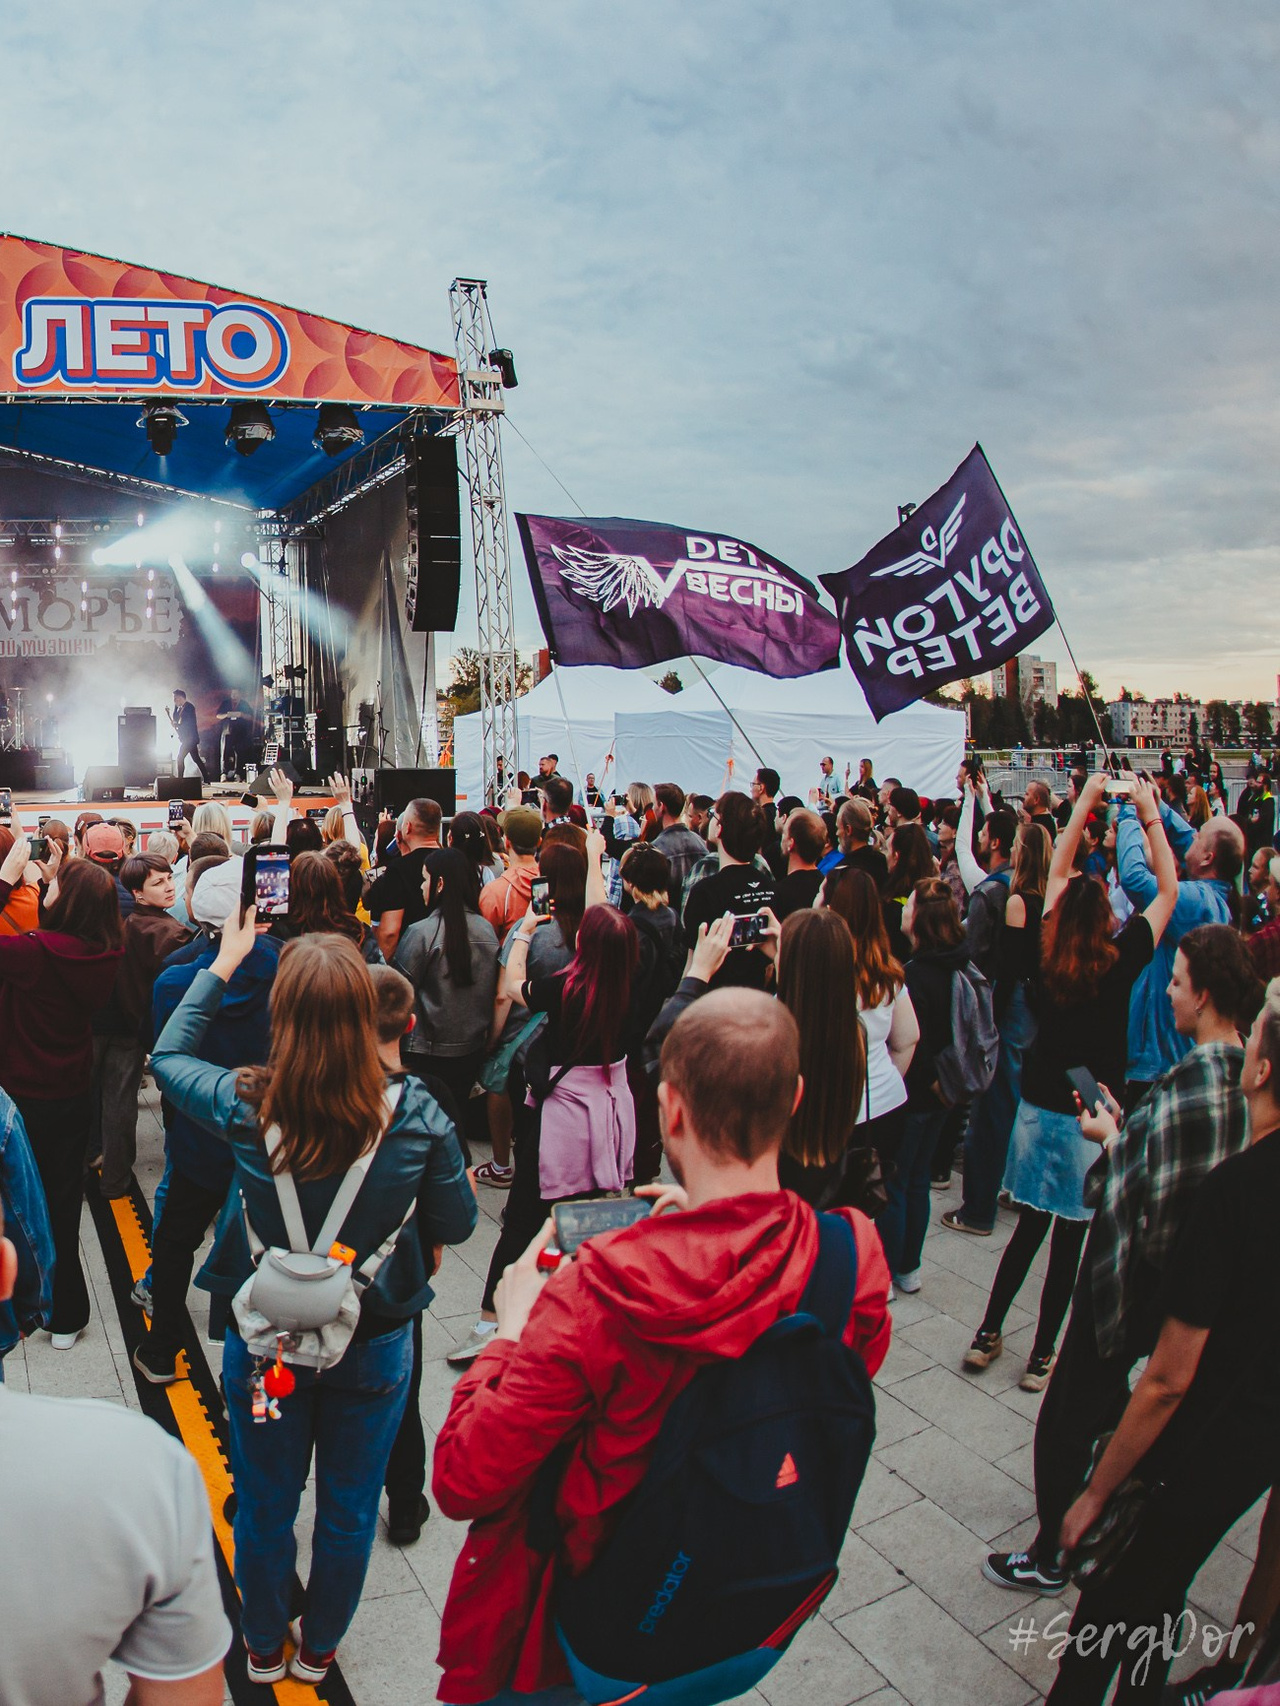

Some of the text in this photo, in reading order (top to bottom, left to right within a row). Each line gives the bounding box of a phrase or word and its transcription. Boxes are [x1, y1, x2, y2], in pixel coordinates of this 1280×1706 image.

[20, 302, 276, 376] ЛЕТО
[685, 571, 805, 617] ВЕСНЫ
[22, 637, 94, 656] МУЗЫКИ
[639, 1550, 691, 1636] predator
